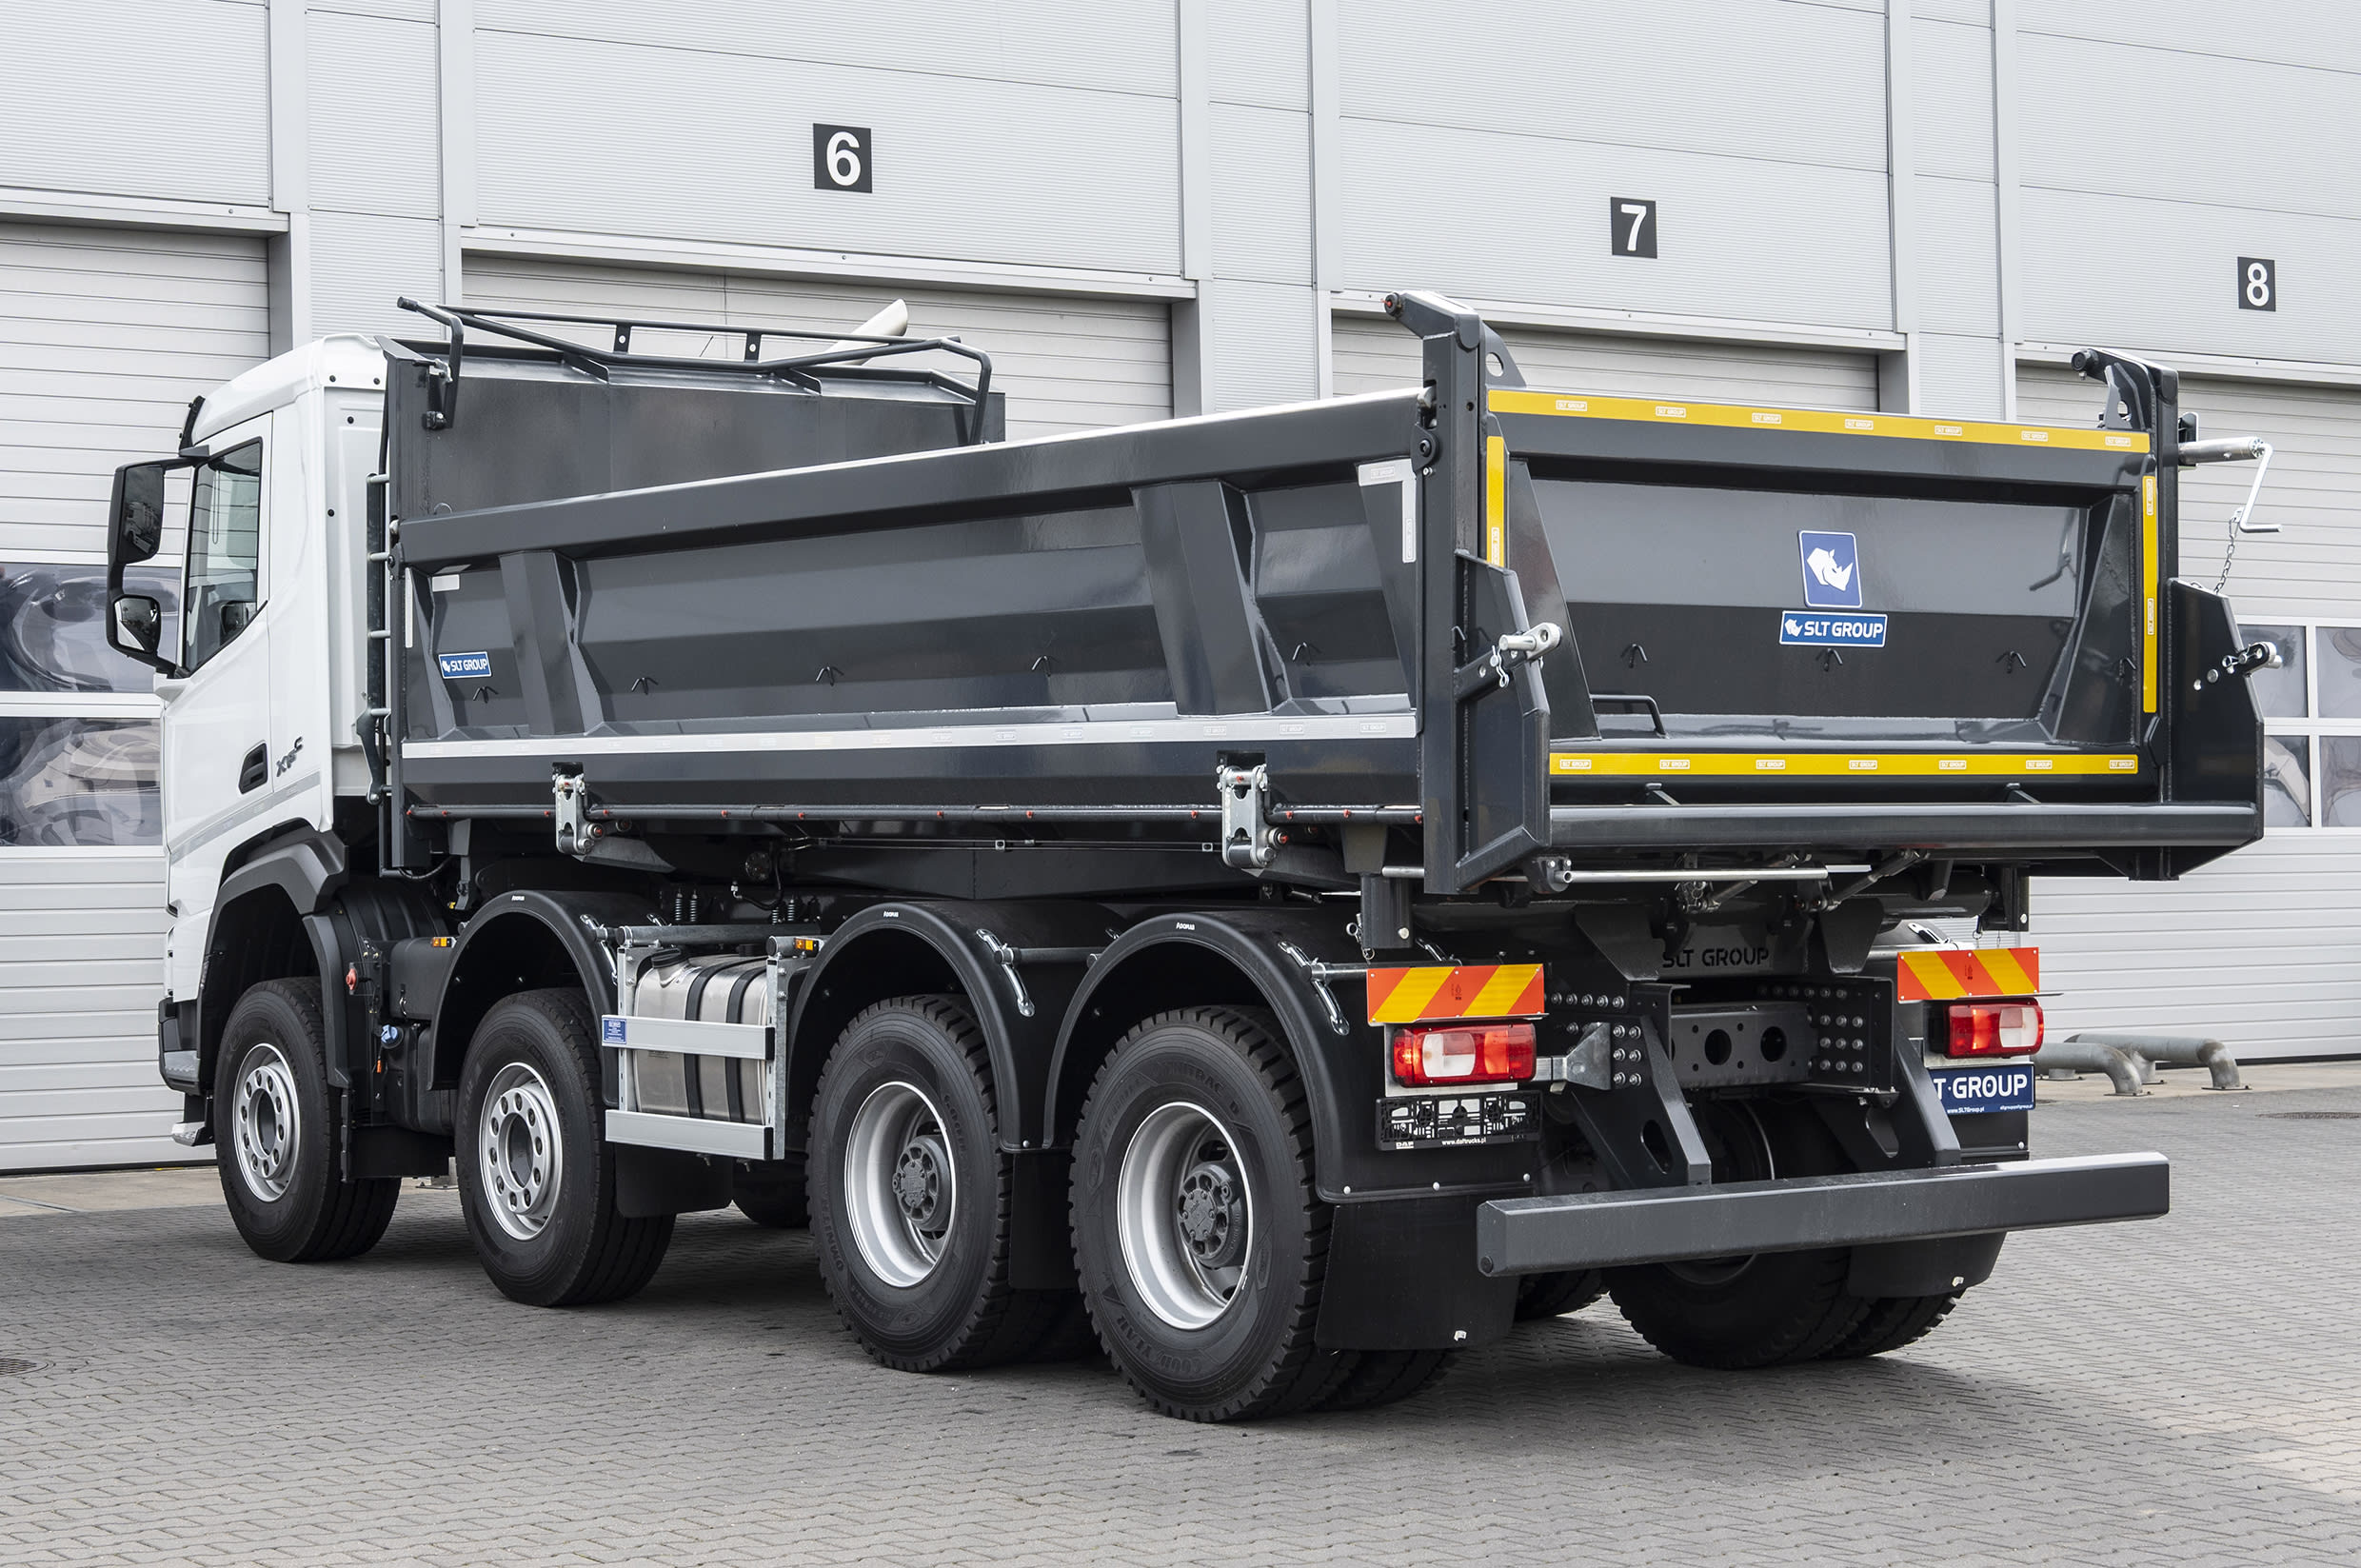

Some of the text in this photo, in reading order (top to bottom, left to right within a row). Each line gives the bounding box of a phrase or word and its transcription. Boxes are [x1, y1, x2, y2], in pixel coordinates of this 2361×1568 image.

[826, 131, 862, 187] 6
[1620, 203, 1647, 251] 7
[2246, 262, 2270, 307] 8
[1804, 621, 1884, 639] SLT GROUP
[450, 658, 487, 672] SLT GROUP
[1661, 947, 1770, 968] SLT GROUP
[1952, 1073, 2028, 1100] GROUP
[1441, 1137, 1487, 1146] www.daftrucks.pl
